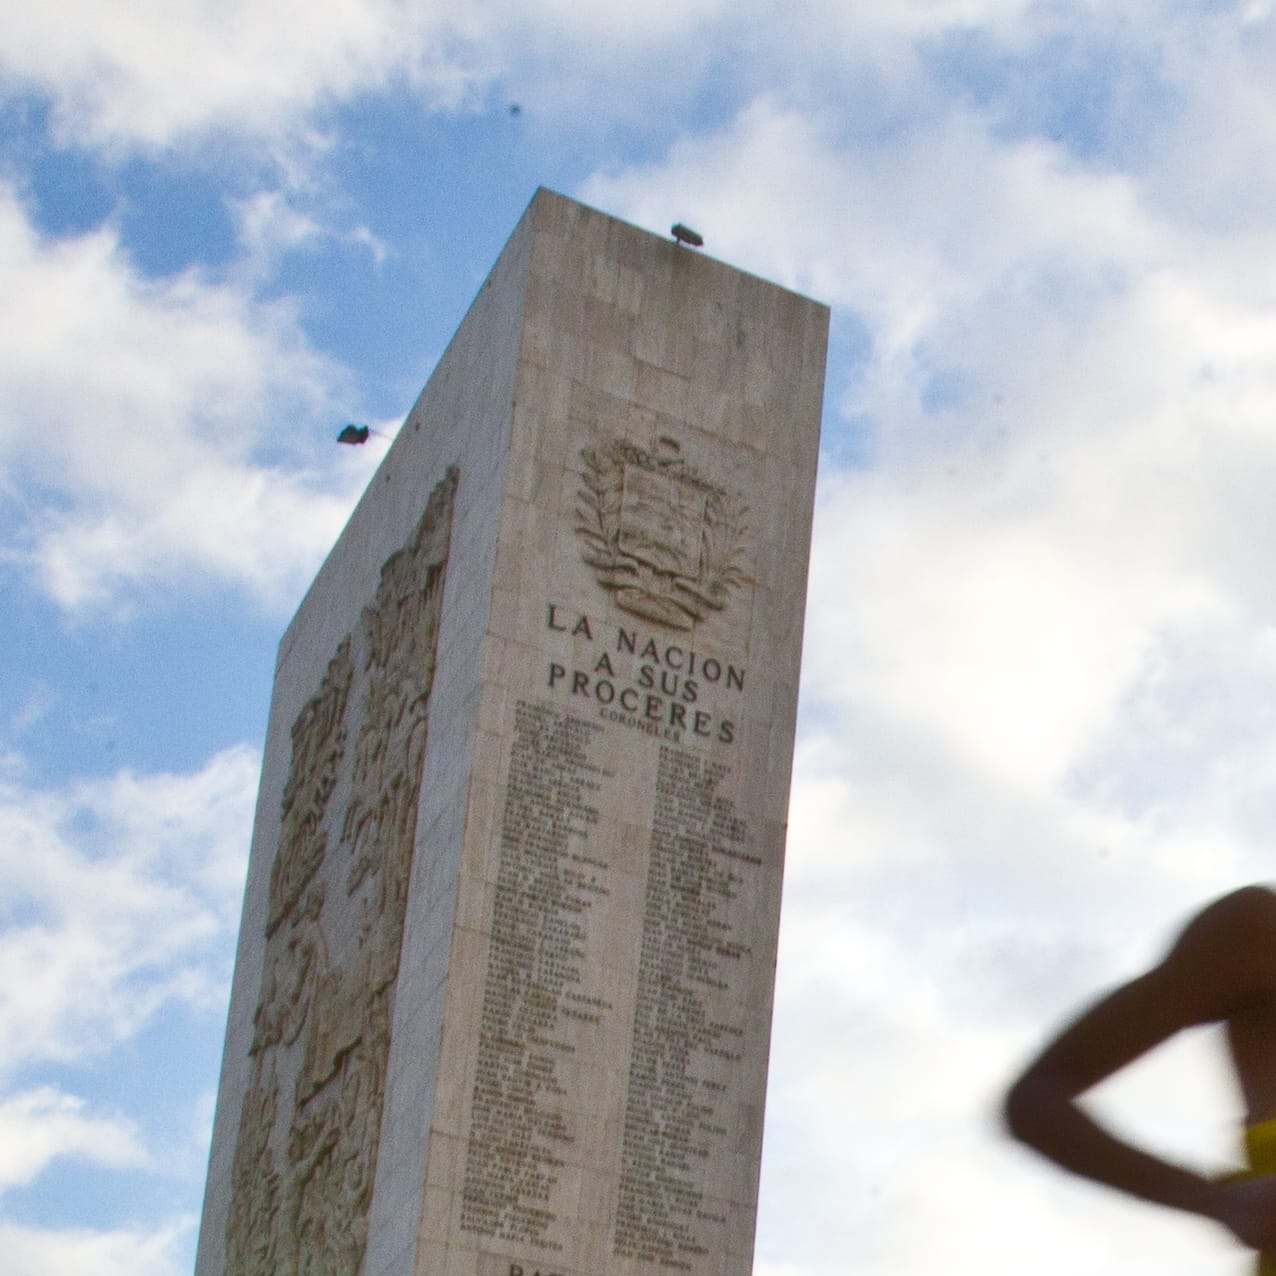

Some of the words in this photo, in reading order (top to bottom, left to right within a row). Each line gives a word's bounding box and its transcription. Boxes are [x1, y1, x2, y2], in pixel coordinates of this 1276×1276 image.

[546, 603, 593, 641] LA
[616, 627, 747, 693] NACION
[593, 651, 615, 676] A
[637, 664, 699, 704] SUS
[546, 662, 735, 745] PROCERES
[600, 707, 681, 744] CORONELES
